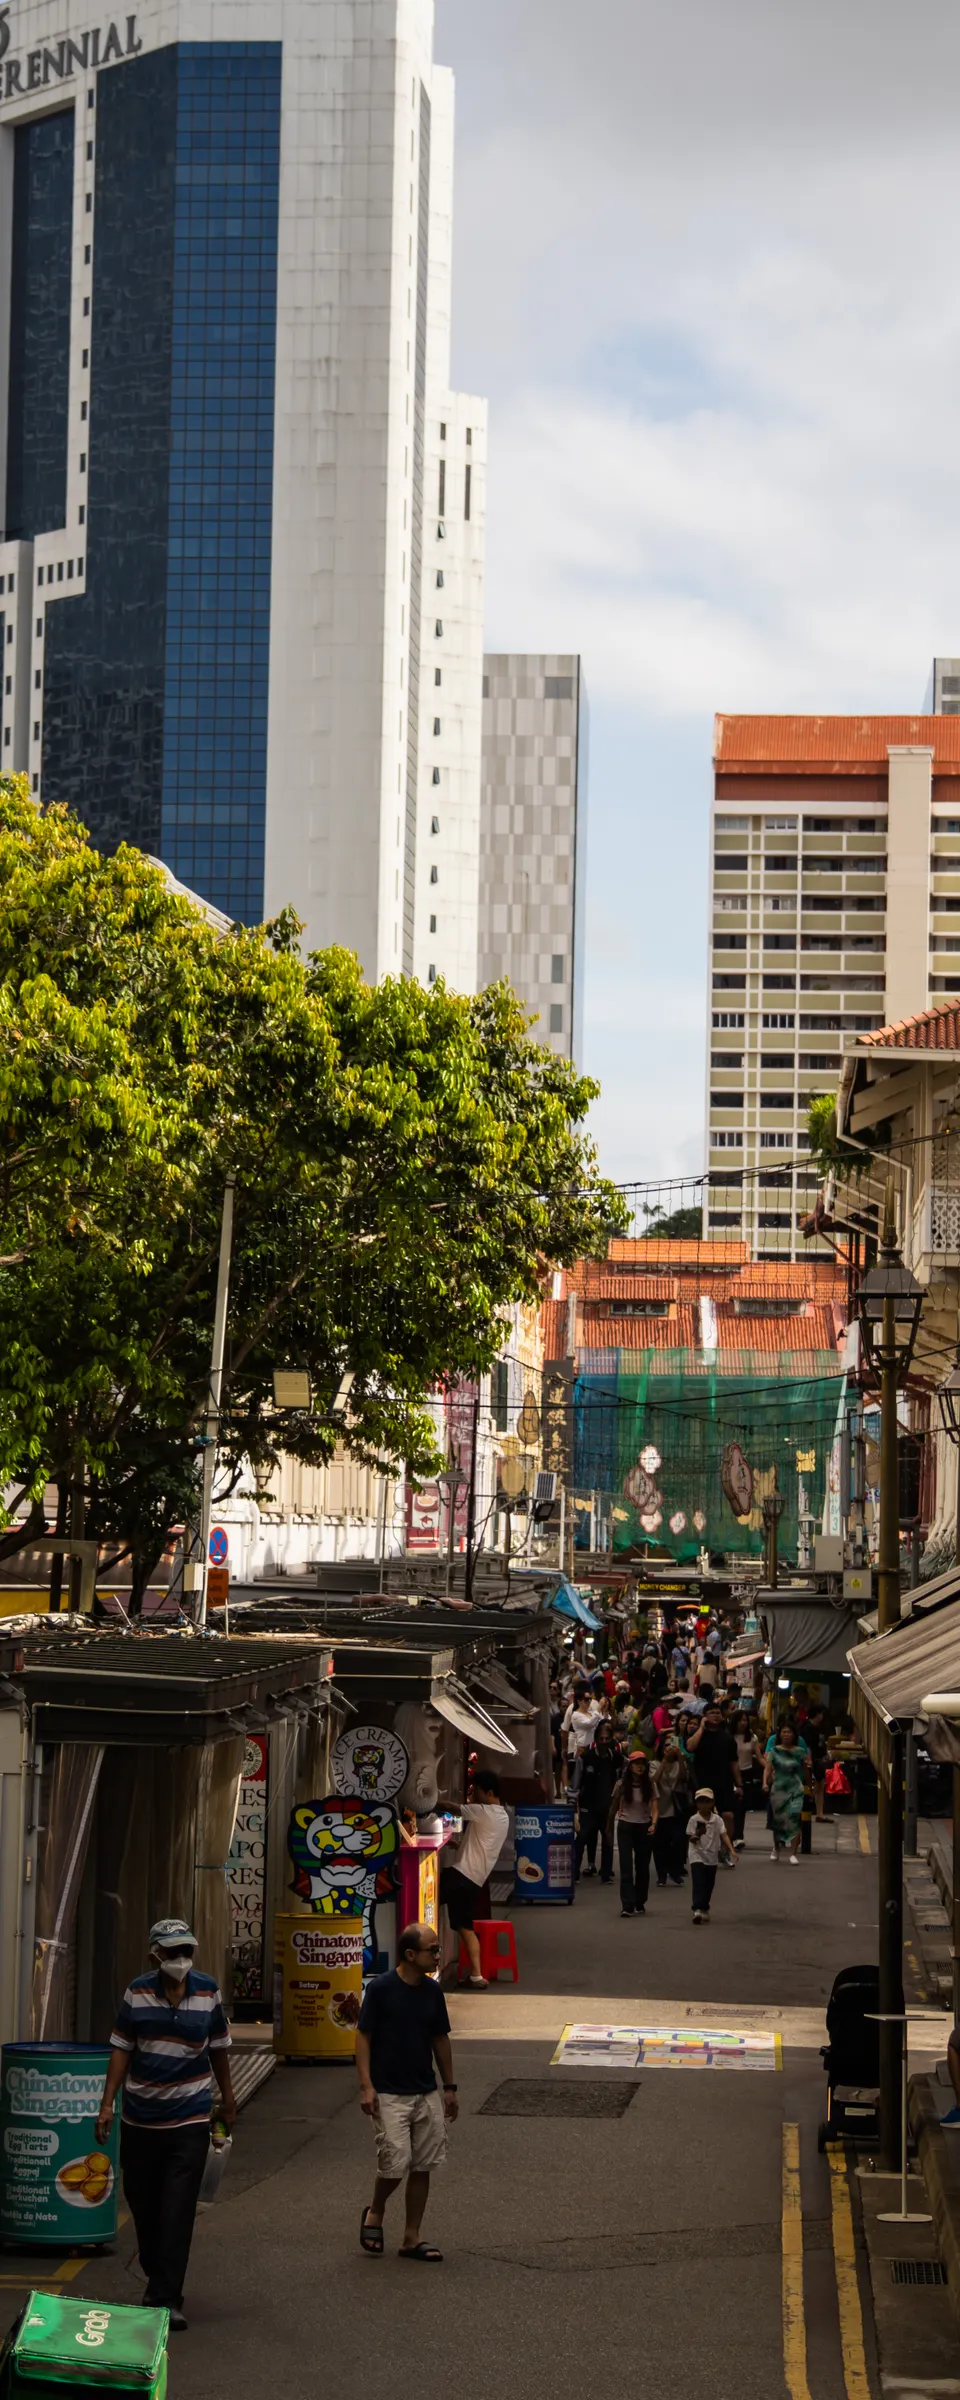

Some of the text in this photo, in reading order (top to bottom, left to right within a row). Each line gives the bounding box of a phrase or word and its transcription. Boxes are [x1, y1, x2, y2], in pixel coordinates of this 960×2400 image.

[0, 15, 142, 99] RENNIAL
[639, 1583, 658, 1591] MONEY
[659, 1583, 686, 1592] CHANGER
[333, 1728, 404, 1763] ICE CREAM
[334, 1766, 404, 1800] SINGAORE
[299, 1982, 320, 1990] Satay
[13, 2091, 100, 2117] Singapo
[8, 2132, 52, 2143] Traditional
[9, 2140, 48, 2151] Egg Tarts
[35, 2212, 58, 2221] Nata
[75, 2310, 111, 2346] Grab
